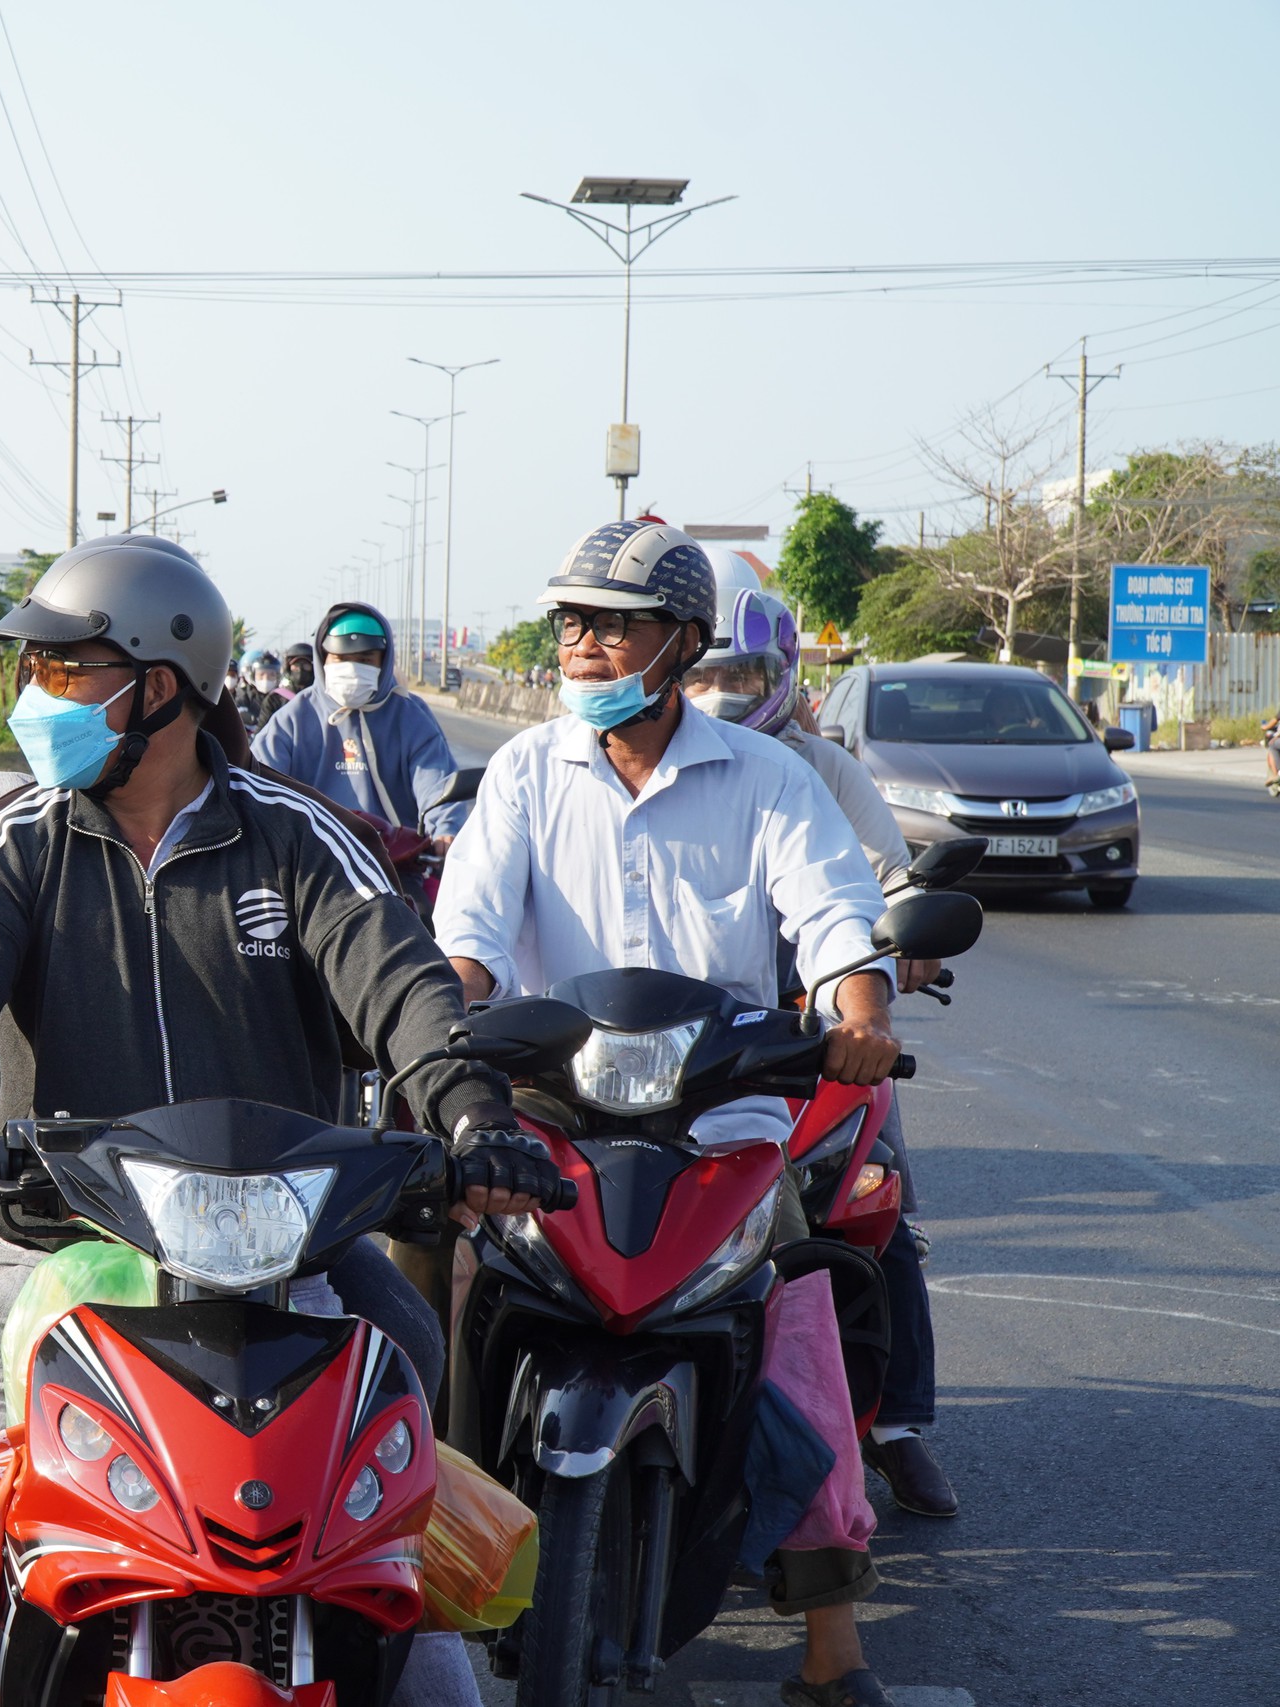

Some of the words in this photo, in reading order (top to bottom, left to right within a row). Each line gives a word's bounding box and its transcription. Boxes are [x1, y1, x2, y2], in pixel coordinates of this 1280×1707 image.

[1127, 575, 1148, 598] ĐOẠN
[1149, 573, 1174, 595] ĐƯỜNG
[1174, 576, 1194, 595] CSGT
[1115, 600, 1144, 623] THƯỜNG
[1145, 602, 1169, 624] XUYÊN
[1170, 599, 1189, 624] KIỂM
[1190, 606, 1204, 624] TRA
[1146, 629, 1160, 653] TỐC
[1161, 631, 1172, 657] ĐỘ
[237, 940, 291, 960] adidas
[610, 1140, 663, 1153] HONDA
